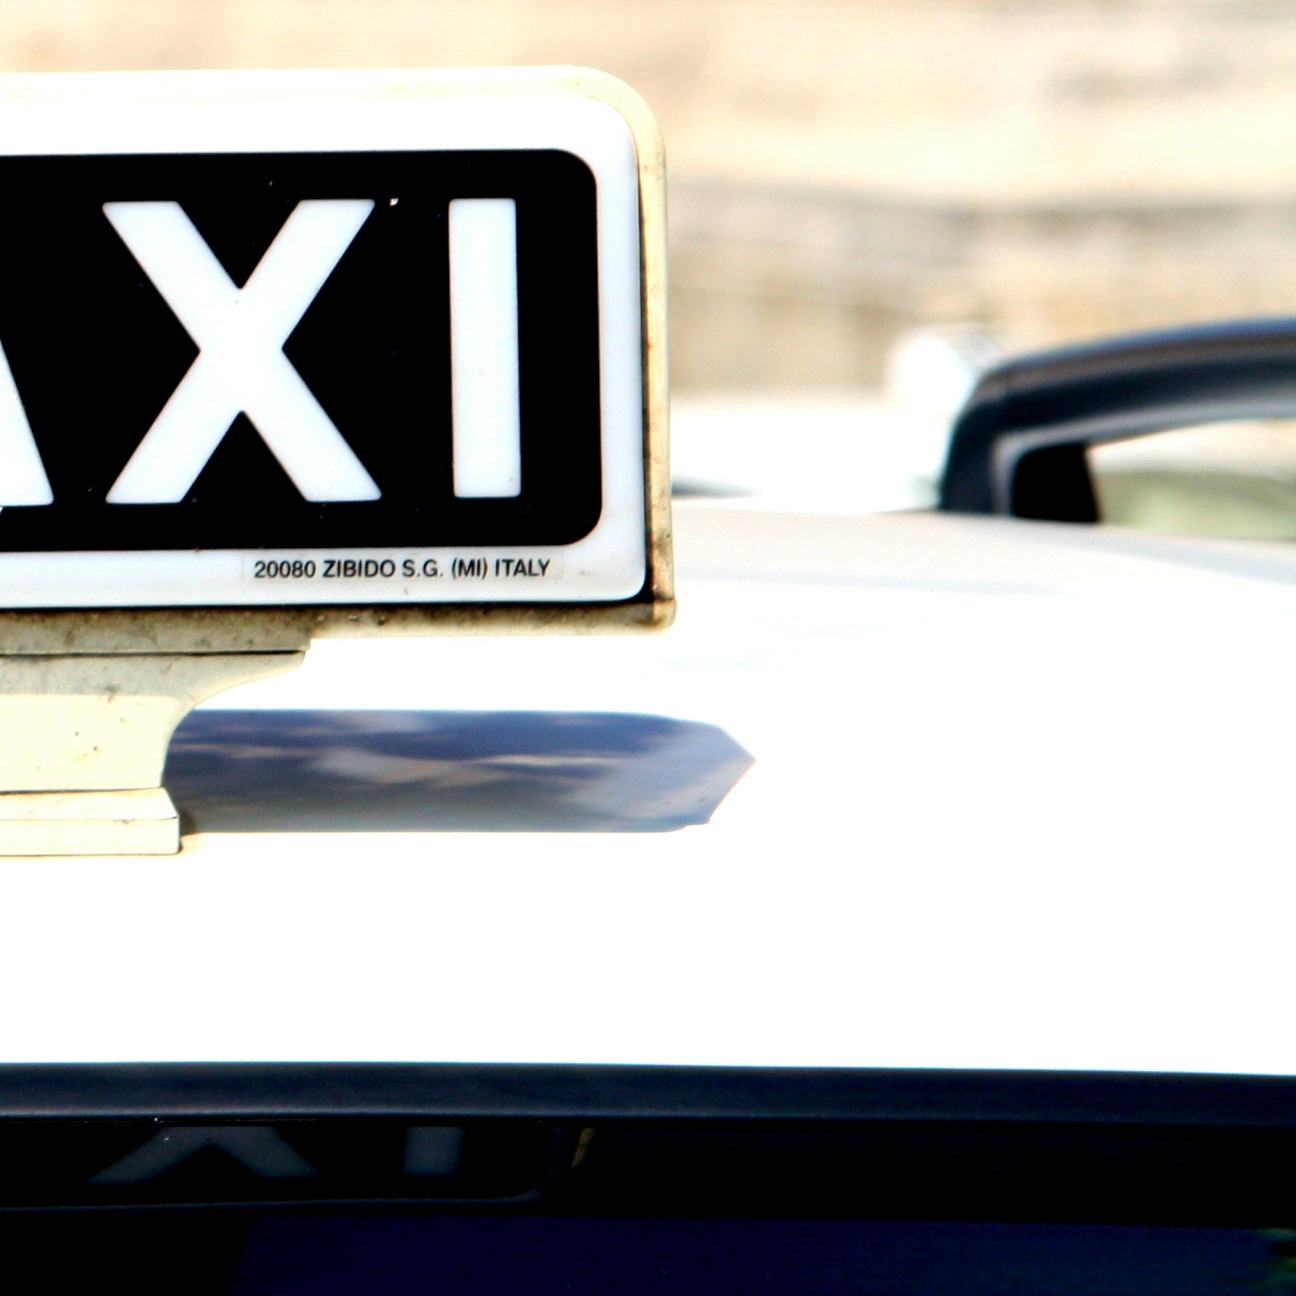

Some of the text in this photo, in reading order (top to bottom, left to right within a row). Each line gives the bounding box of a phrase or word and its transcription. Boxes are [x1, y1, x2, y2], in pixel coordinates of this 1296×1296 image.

[254, 557, 551, 580] 20080 ZIBIDO S.G. (MI) ITALY
